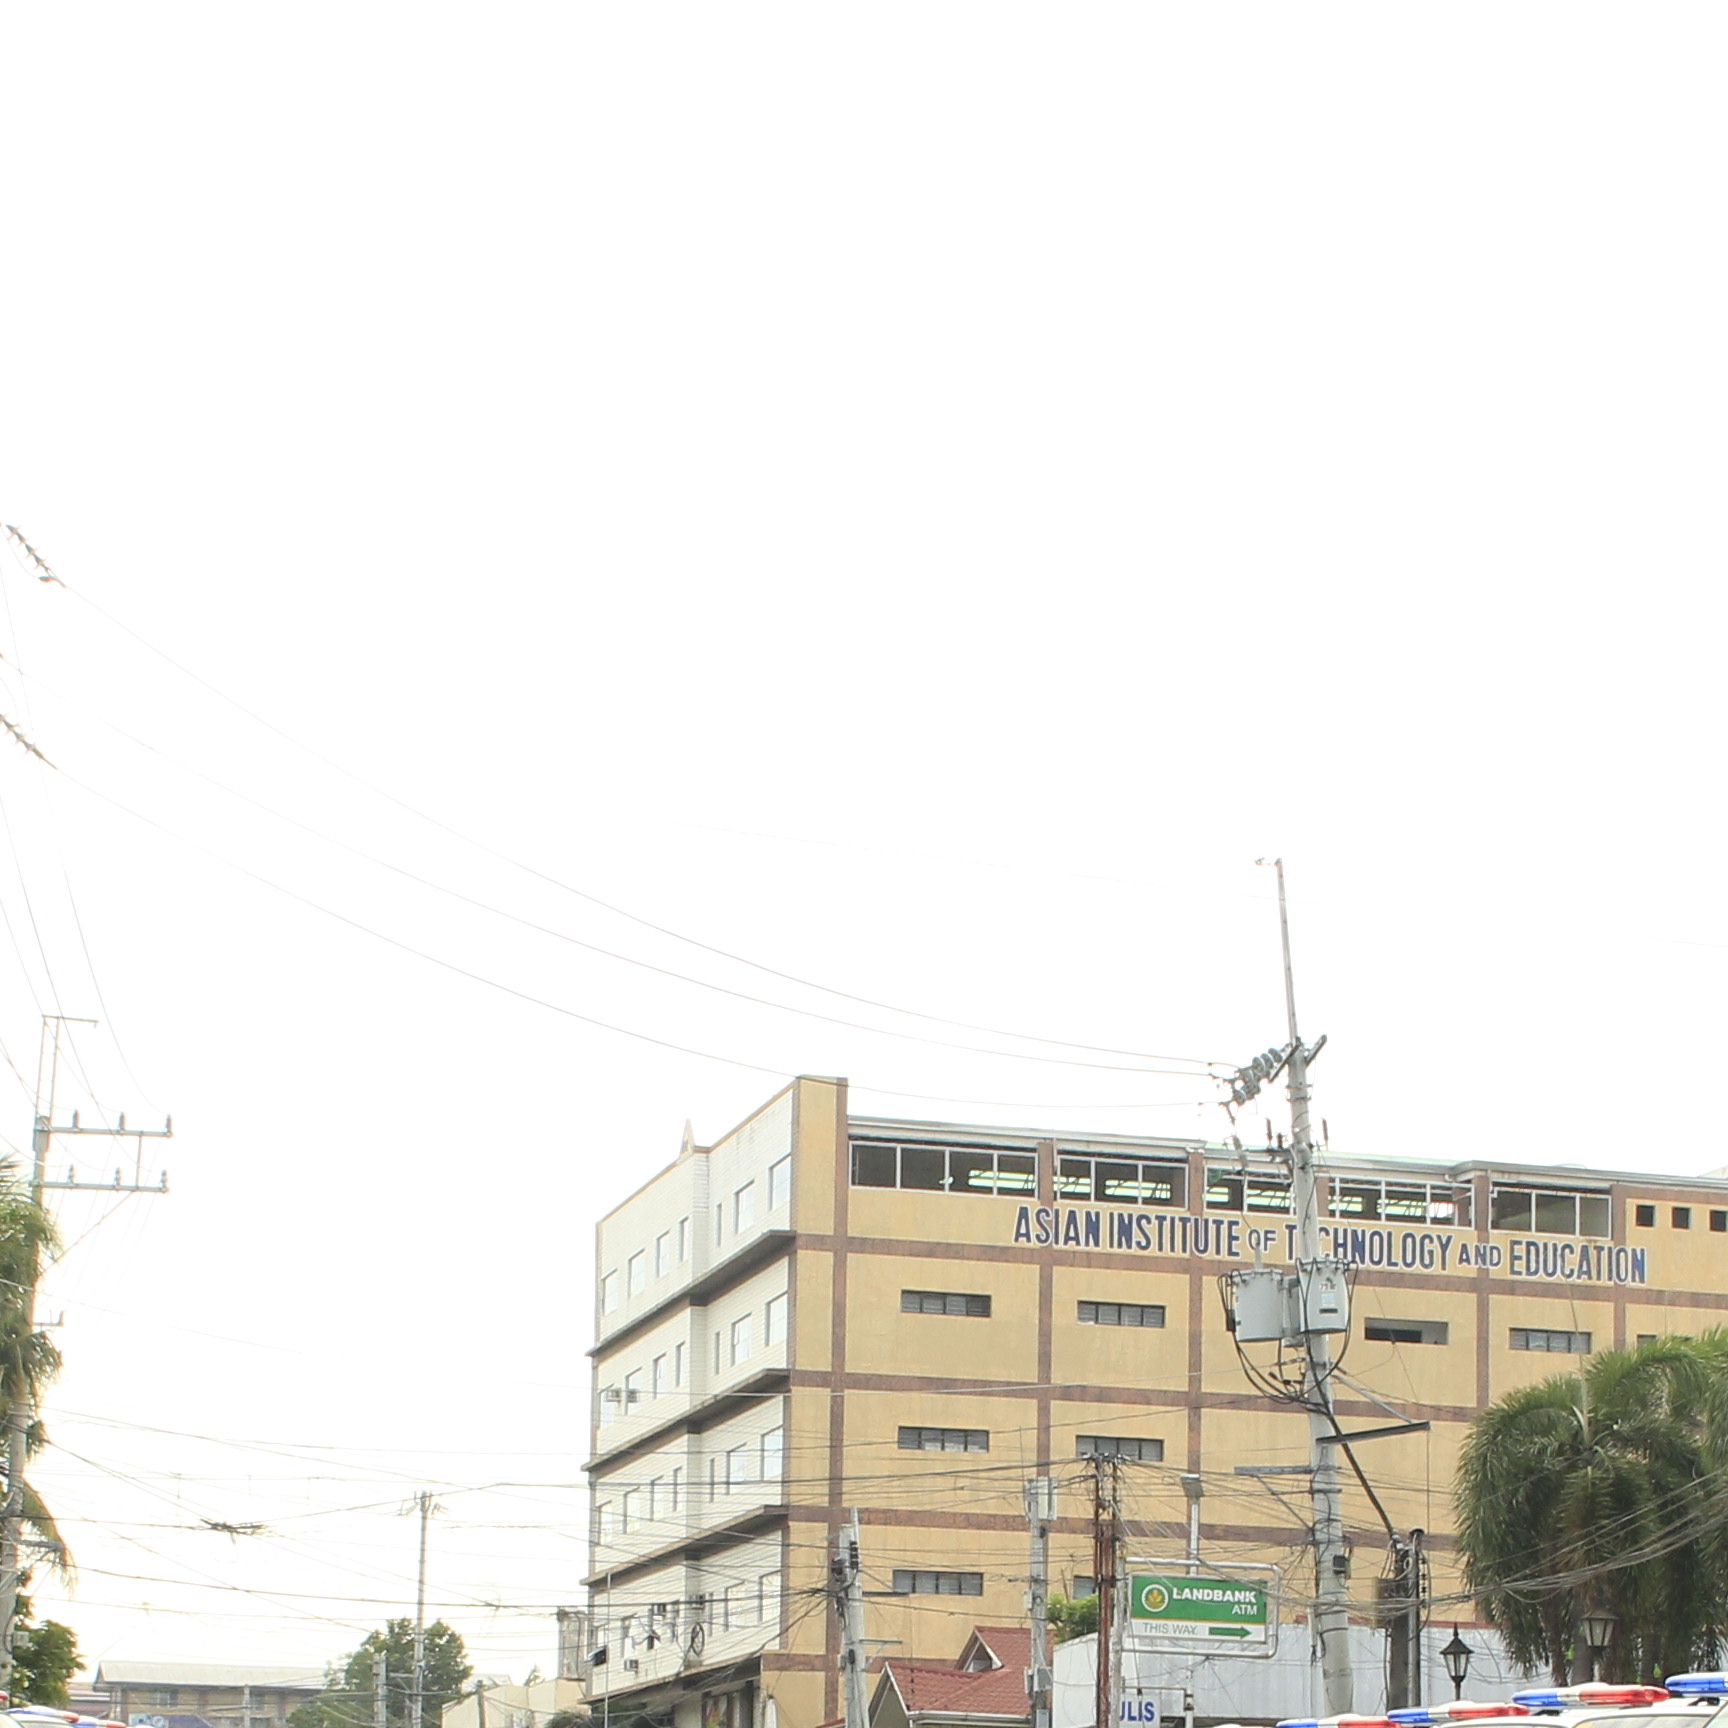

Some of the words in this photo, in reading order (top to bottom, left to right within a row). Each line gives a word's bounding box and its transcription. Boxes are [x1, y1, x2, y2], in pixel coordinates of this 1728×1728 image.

[1013, 1205, 1102, 1249] ASIAN
[1109, 1211, 1242, 1257] INSTITUTE
[1247, 1228, 1277, 1251] OF
[1284, 1223, 1453, 1271] TCHNOLOGY
[1458, 1241, 1502, 1268] AND
[1509, 1239, 1646, 1285] EDUCATION
[1172, 1587, 1257, 1604] LANDBANK
[1231, 1604, 1257, 1616] ATM
[1142, 1622, 1170, 1634] THIS
[1172, 1624, 1198, 1635] WAY
